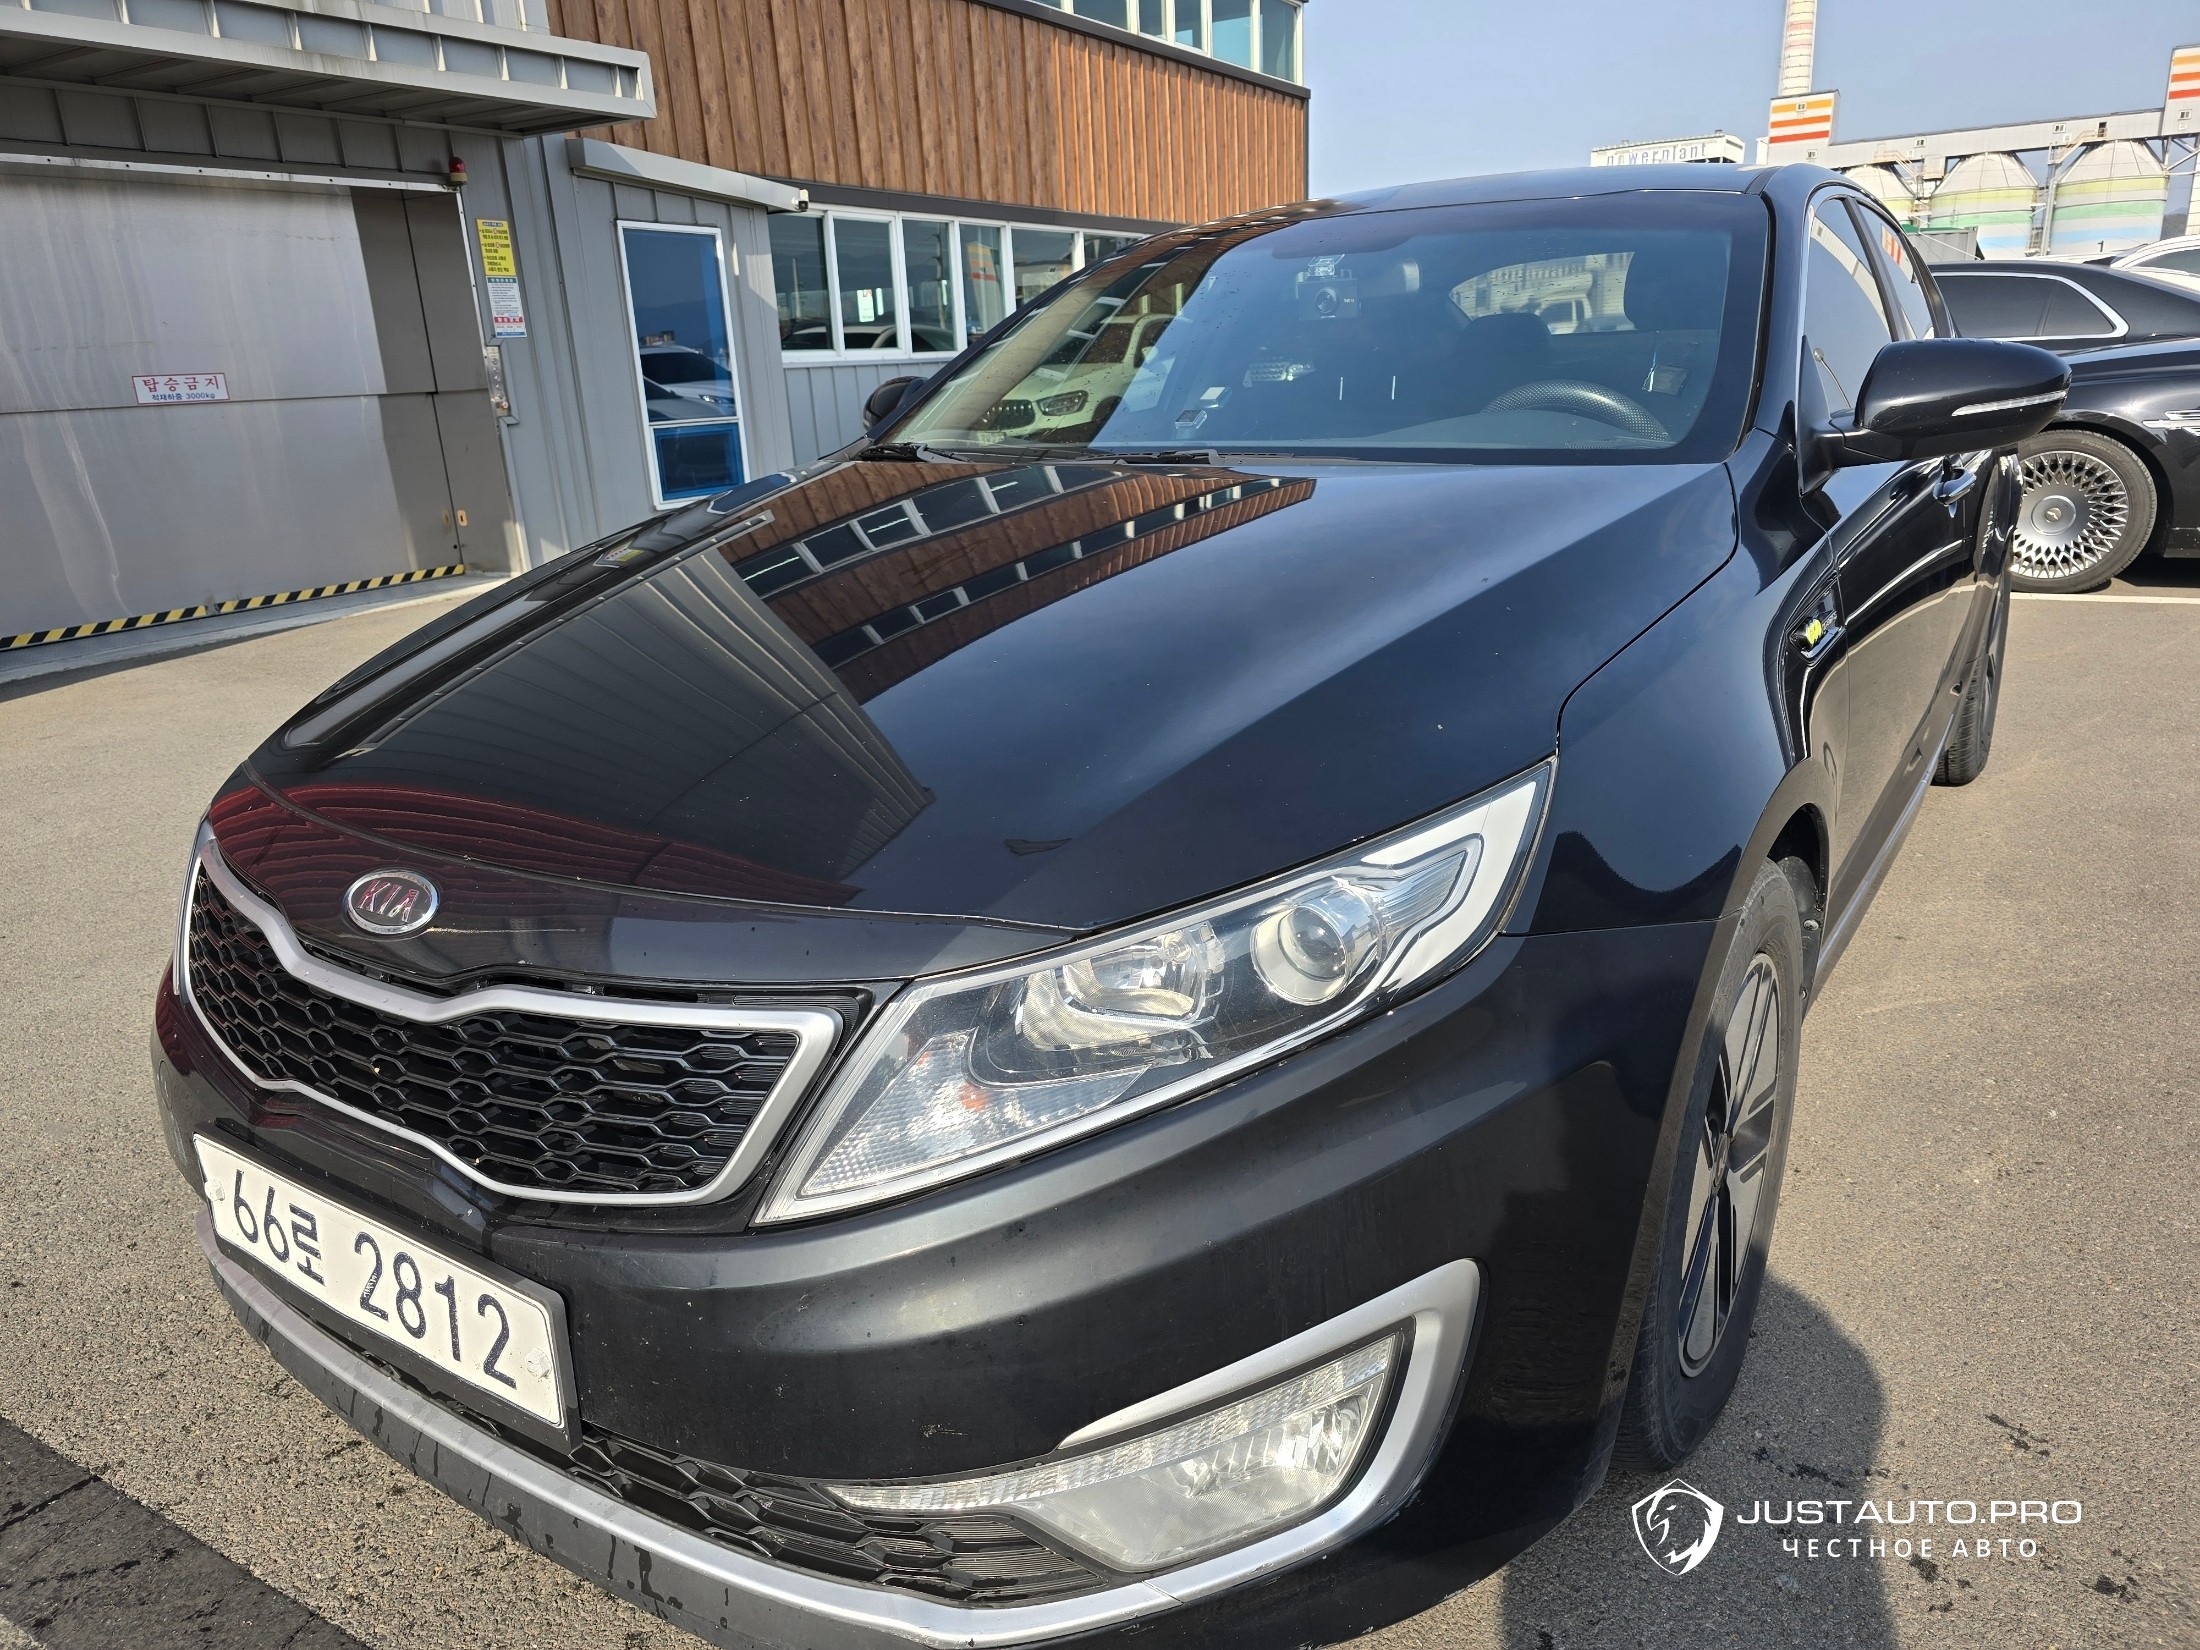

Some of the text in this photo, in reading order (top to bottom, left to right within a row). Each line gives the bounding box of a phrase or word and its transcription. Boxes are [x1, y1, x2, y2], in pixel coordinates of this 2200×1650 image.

[142, 375, 219, 393] 탑승금지
[356, 880, 419, 922] KIA
[233, 1169, 518, 1390] 66로 2812
